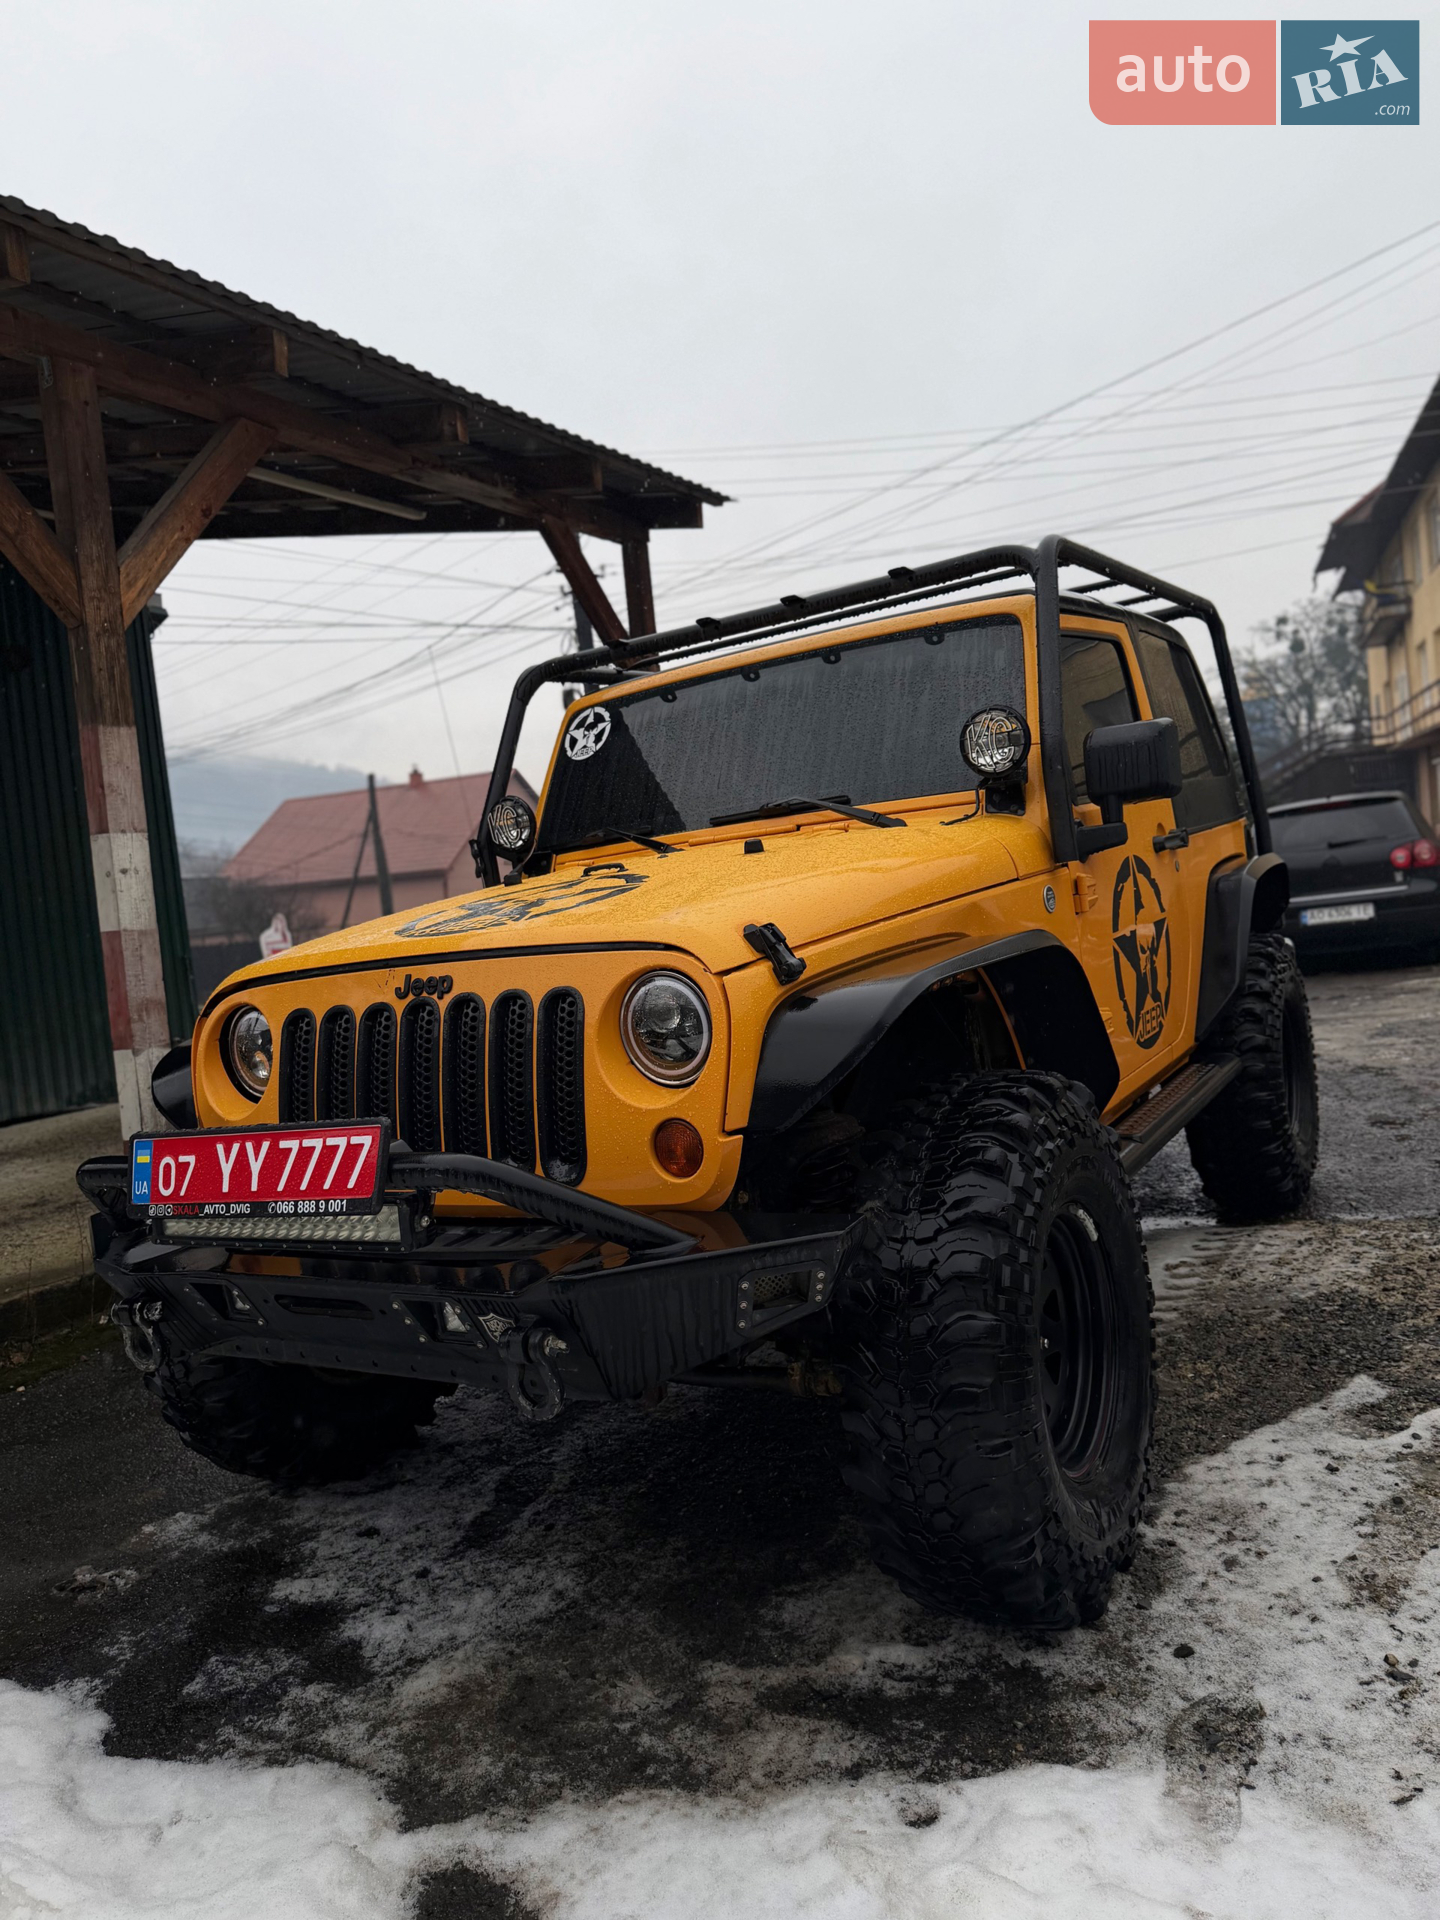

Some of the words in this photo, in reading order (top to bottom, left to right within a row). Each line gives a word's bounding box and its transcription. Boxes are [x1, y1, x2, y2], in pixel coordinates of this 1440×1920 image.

[967, 714, 1015, 769] KC
[488, 804, 521, 848] KC
[395, 974, 453, 1000] Jeep
[1138, 1003, 1162, 1040] JEEP
[135, 1180, 149, 1195] UA
[158, 1155, 196, 1197] 07
[276, 1201, 295, 1214] 066
[297, 1200, 316, 1214] 888
[319, 1200, 326, 1213] 9
[328, 1199, 347, 1213] 001
